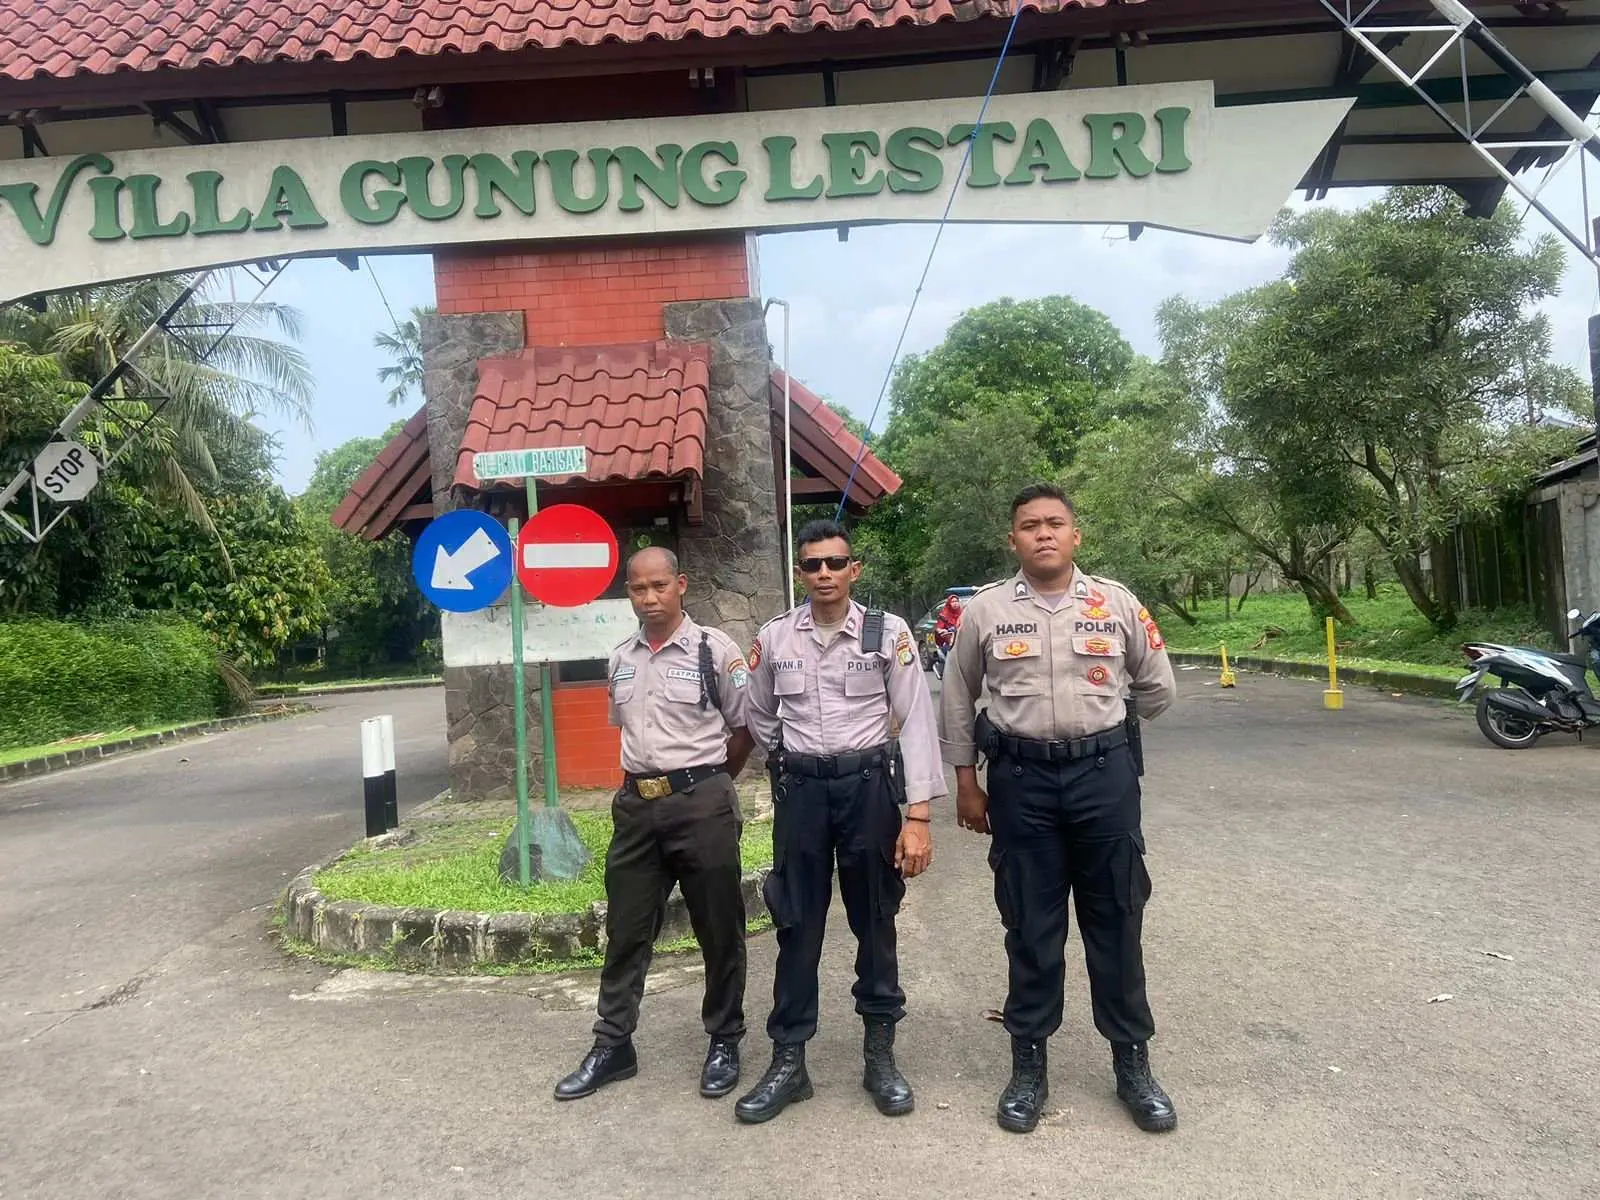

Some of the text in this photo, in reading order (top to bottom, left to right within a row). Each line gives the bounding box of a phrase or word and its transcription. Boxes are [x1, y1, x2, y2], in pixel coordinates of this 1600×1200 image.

[0, 106, 1192, 246] VILLA GUNUNG LESTARI
[532, 448, 581, 472] BARISAN
[44, 447, 85, 494] STOP
[996, 623, 1038, 635] HARDI
[1074, 621, 1116, 634] POLRI
[847, 660, 881, 671] POLRI
